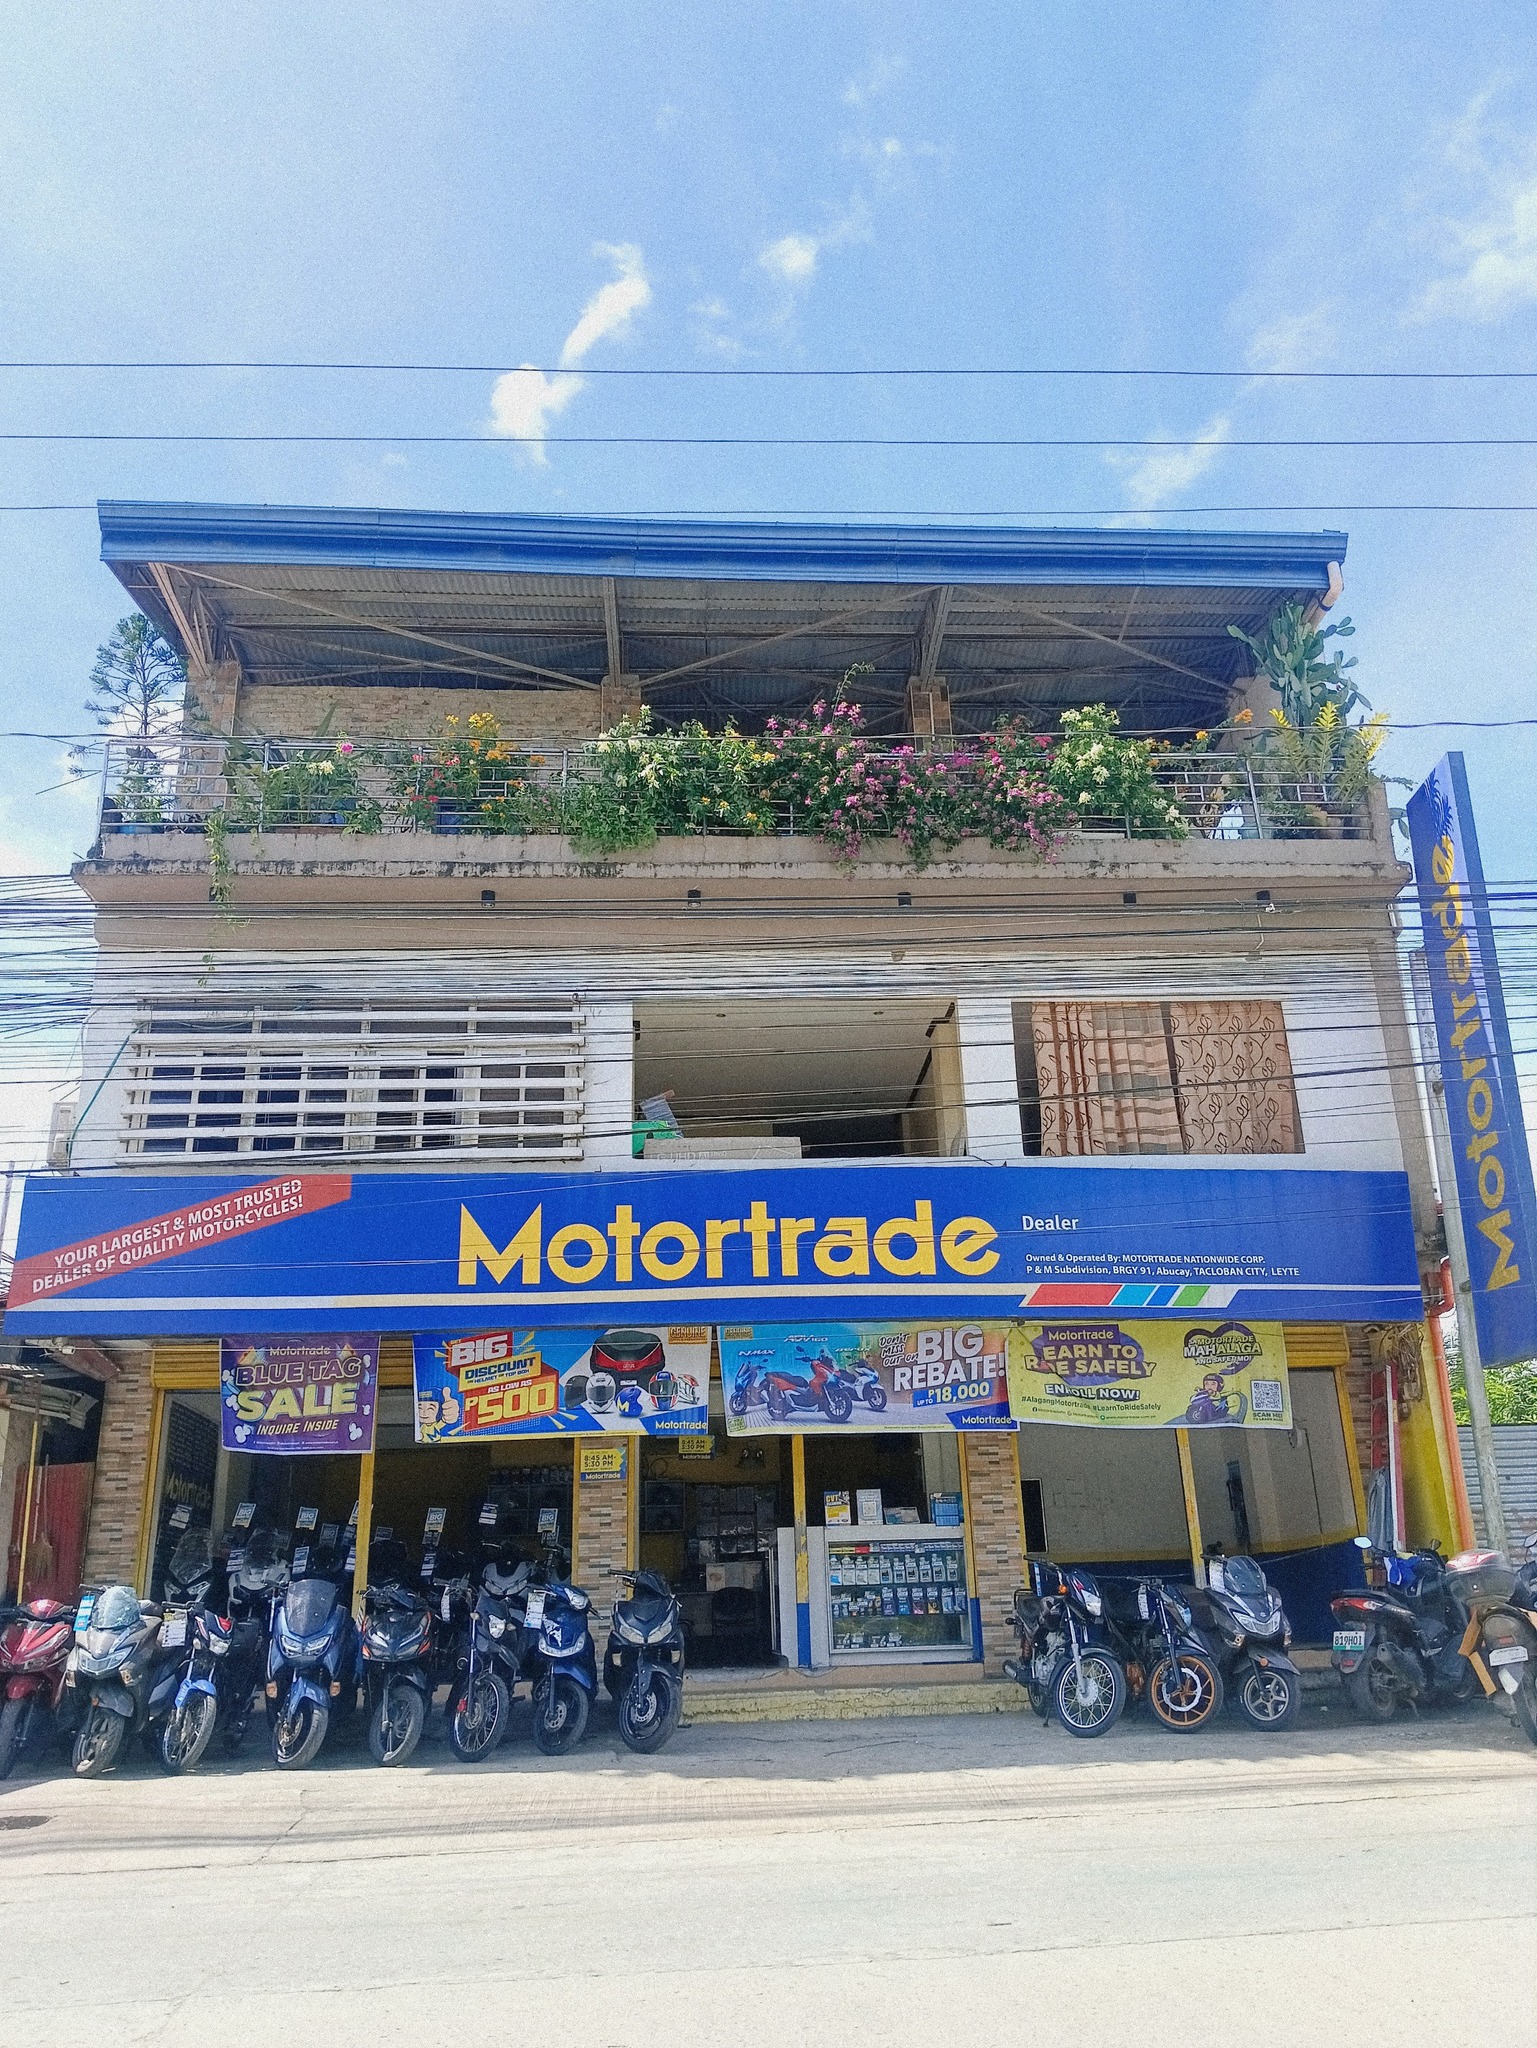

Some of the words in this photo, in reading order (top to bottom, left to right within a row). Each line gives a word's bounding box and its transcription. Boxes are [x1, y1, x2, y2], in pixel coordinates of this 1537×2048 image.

[1432, 835, 1520, 1291] Motortrade
[54, 1244, 98, 1268] YOUR
[102, 1220, 170, 1254] LARGEST
[172, 1216, 186, 1231] &
[188, 1201, 232, 1227] MOST
[233, 1179, 302, 1211] TRUSTED
[1021, 1214, 1079, 1231] Dealer
[32, 1264, 92, 1293] DEALER
[95, 1255, 116, 1273] OF
[119, 1232, 187, 1266] QUALITY
[189, 1195, 304, 1243] MOTORCYCLES!
[457, 1199, 1001, 1286] Motortrade
[1025, 1253, 1056, 1262] Owned
[1057, 1254, 1065, 1262] &
[1065, 1253, 1106, 1264] Operated
[1107, 1254, 1121, 1264] By:
[1122, 1255, 1182, 1264] MOTORTRADE
[1183, 1255, 1240, 1264] NATIONWIDE
[1240, 1255, 1266, 1264] CORP.
[1026, 1265, 1033, 1274] P
[1034, 1265, 1042, 1274] &
[1043, 1265, 1053, 1274] M
[1054, 1265, 1111, 1276] Subdivision,
[1113, 1266, 1138, 1275] BRGY
[1140, 1266, 1155, 1276] 91,
[1156, 1266, 1193, 1278] Abucay,
[1193, 1267, 1244, 1276] TACLOBAN
[1245, 1267, 1268, 1277] CITY,
[1271, 1267, 1300, 1276] LEYTE
[917, 1324, 984, 1365] BIG
[1048, 1331, 1114, 1341] Motortrade
[270, 1345, 331, 1356] Motortrade
[451, 1335, 508, 1367] BIG
[1042, 1344, 1103, 1360] EARN
[1108, 1344, 1138, 1359] TO
[1184, 1342, 1262, 1357] MAHALAGA
[236, 1362, 304, 1386] BLUE
[309, 1357, 362, 1381] TAG
[465, 1357, 536, 1380] DISCOUNT
[893, 1352, 1006, 1392] REBATE!
[1075, 1359, 1156, 1377] SAFELY
[500, 1382, 520, 1391] LOW
[520, 1380, 533, 1388] AS
[1099, 1388, 1140, 1400] NOW!
[236, 1382, 360, 1422] SALE
[257, 1423, 300, 1435] INQUIRE
[303, 1419, 340, 1432] INSIDE
[655, 1420, 708, 1430] Motortrade
[961, 1415, 1012, 1425] Motortrade
